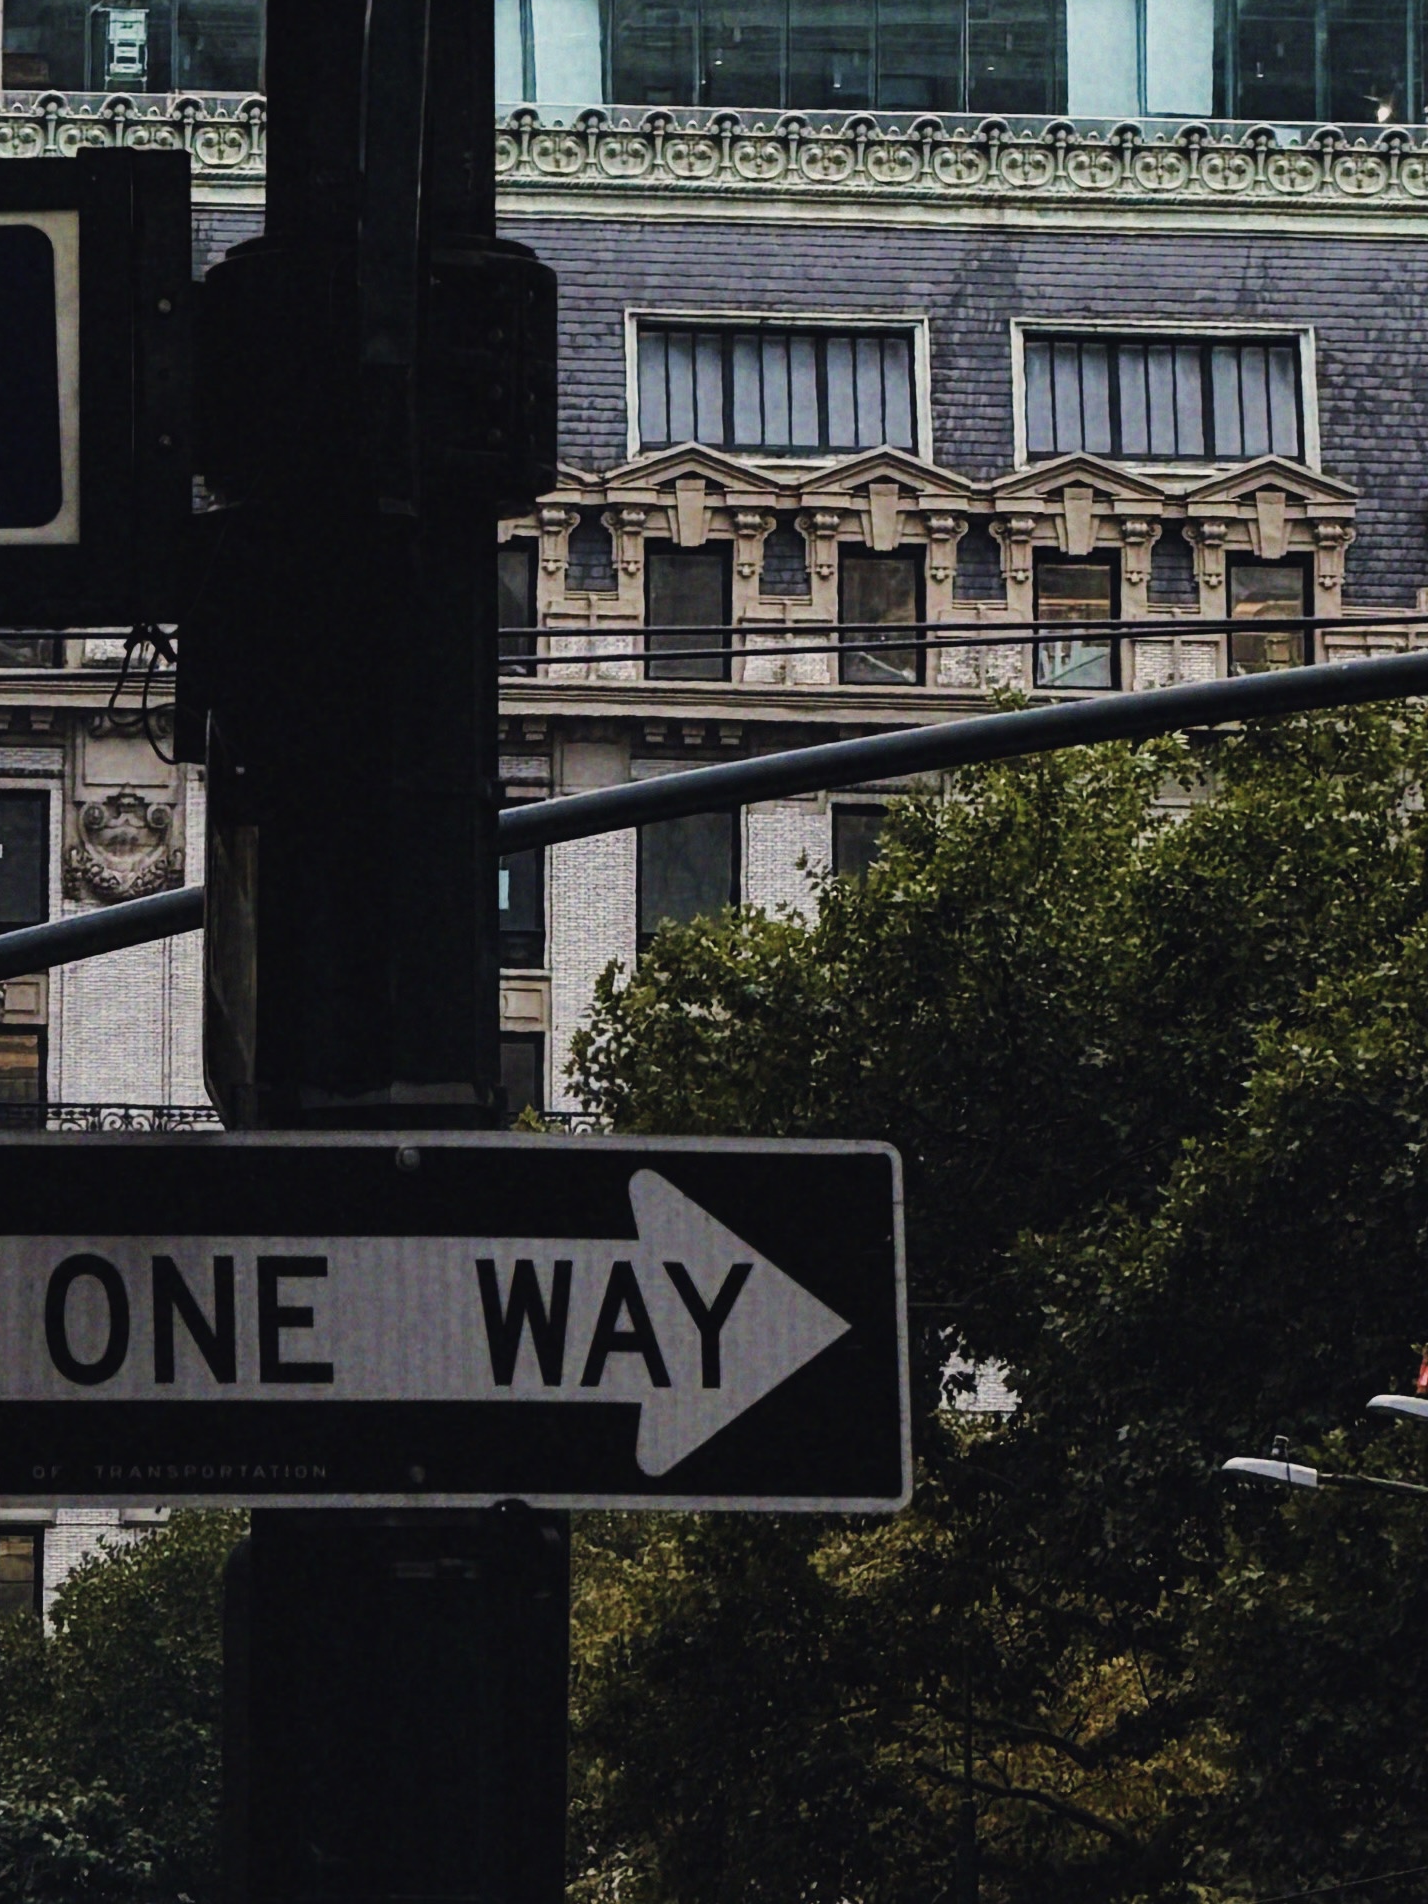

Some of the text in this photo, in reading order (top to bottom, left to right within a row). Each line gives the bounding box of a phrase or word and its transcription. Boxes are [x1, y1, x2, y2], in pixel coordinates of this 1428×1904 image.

[43, 1252, 754, 1389] ONE WAY
[31, 1465, 61, 1480] OF
[93, 1463, 329, 1481] TRANSPORTATION
